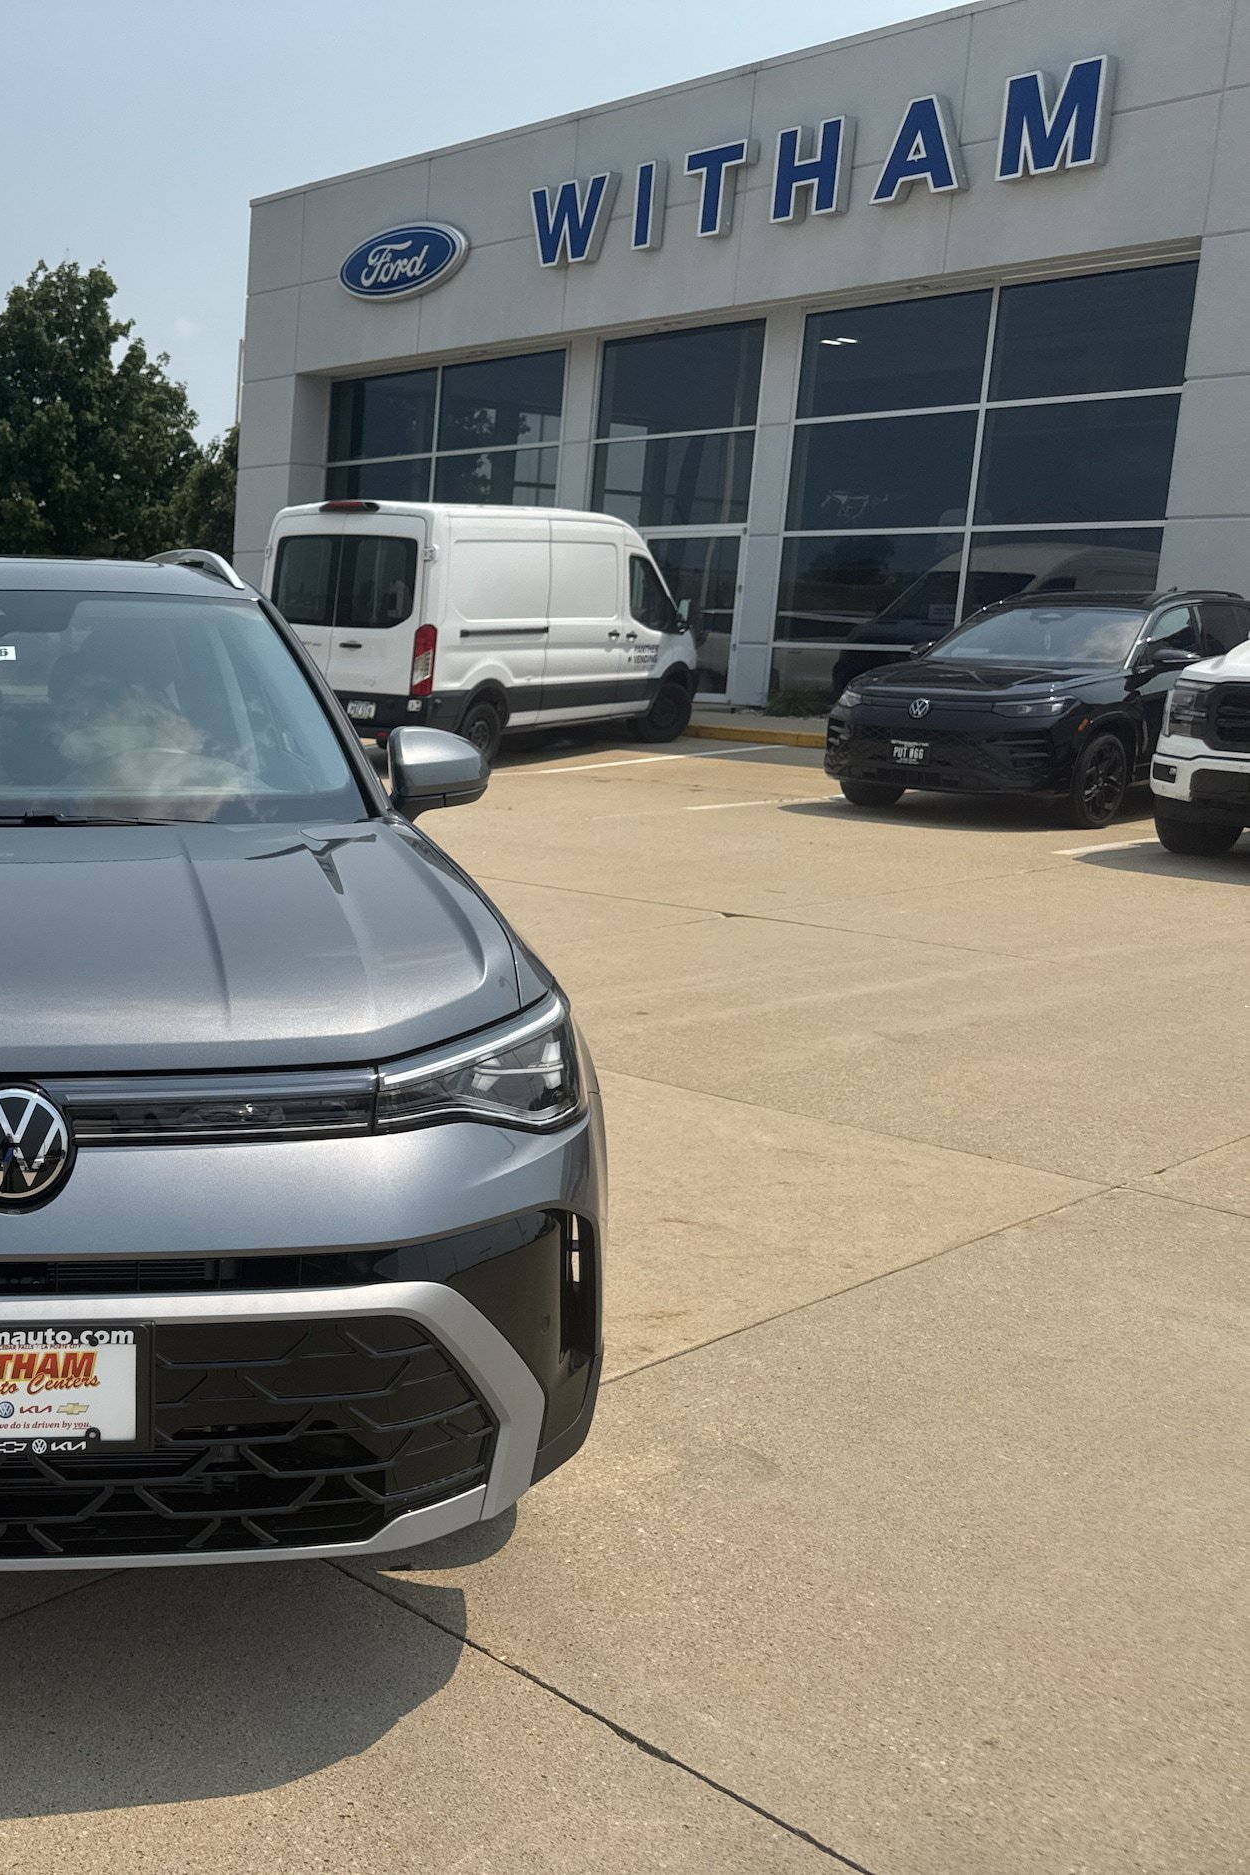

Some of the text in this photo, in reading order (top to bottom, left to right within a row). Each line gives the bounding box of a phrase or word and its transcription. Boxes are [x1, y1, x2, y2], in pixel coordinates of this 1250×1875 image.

[529, 54, 1114, 268] WITHAM
[360, 239, 430, 288] Ford
[27, 1372, 100, 1395] Centers
[10, 1422, 21, 1430] do
[23, 1421, 30, 1430] is
[32, 1420, 60, 1430] driven
[61, 1420, 72, 1431] by
